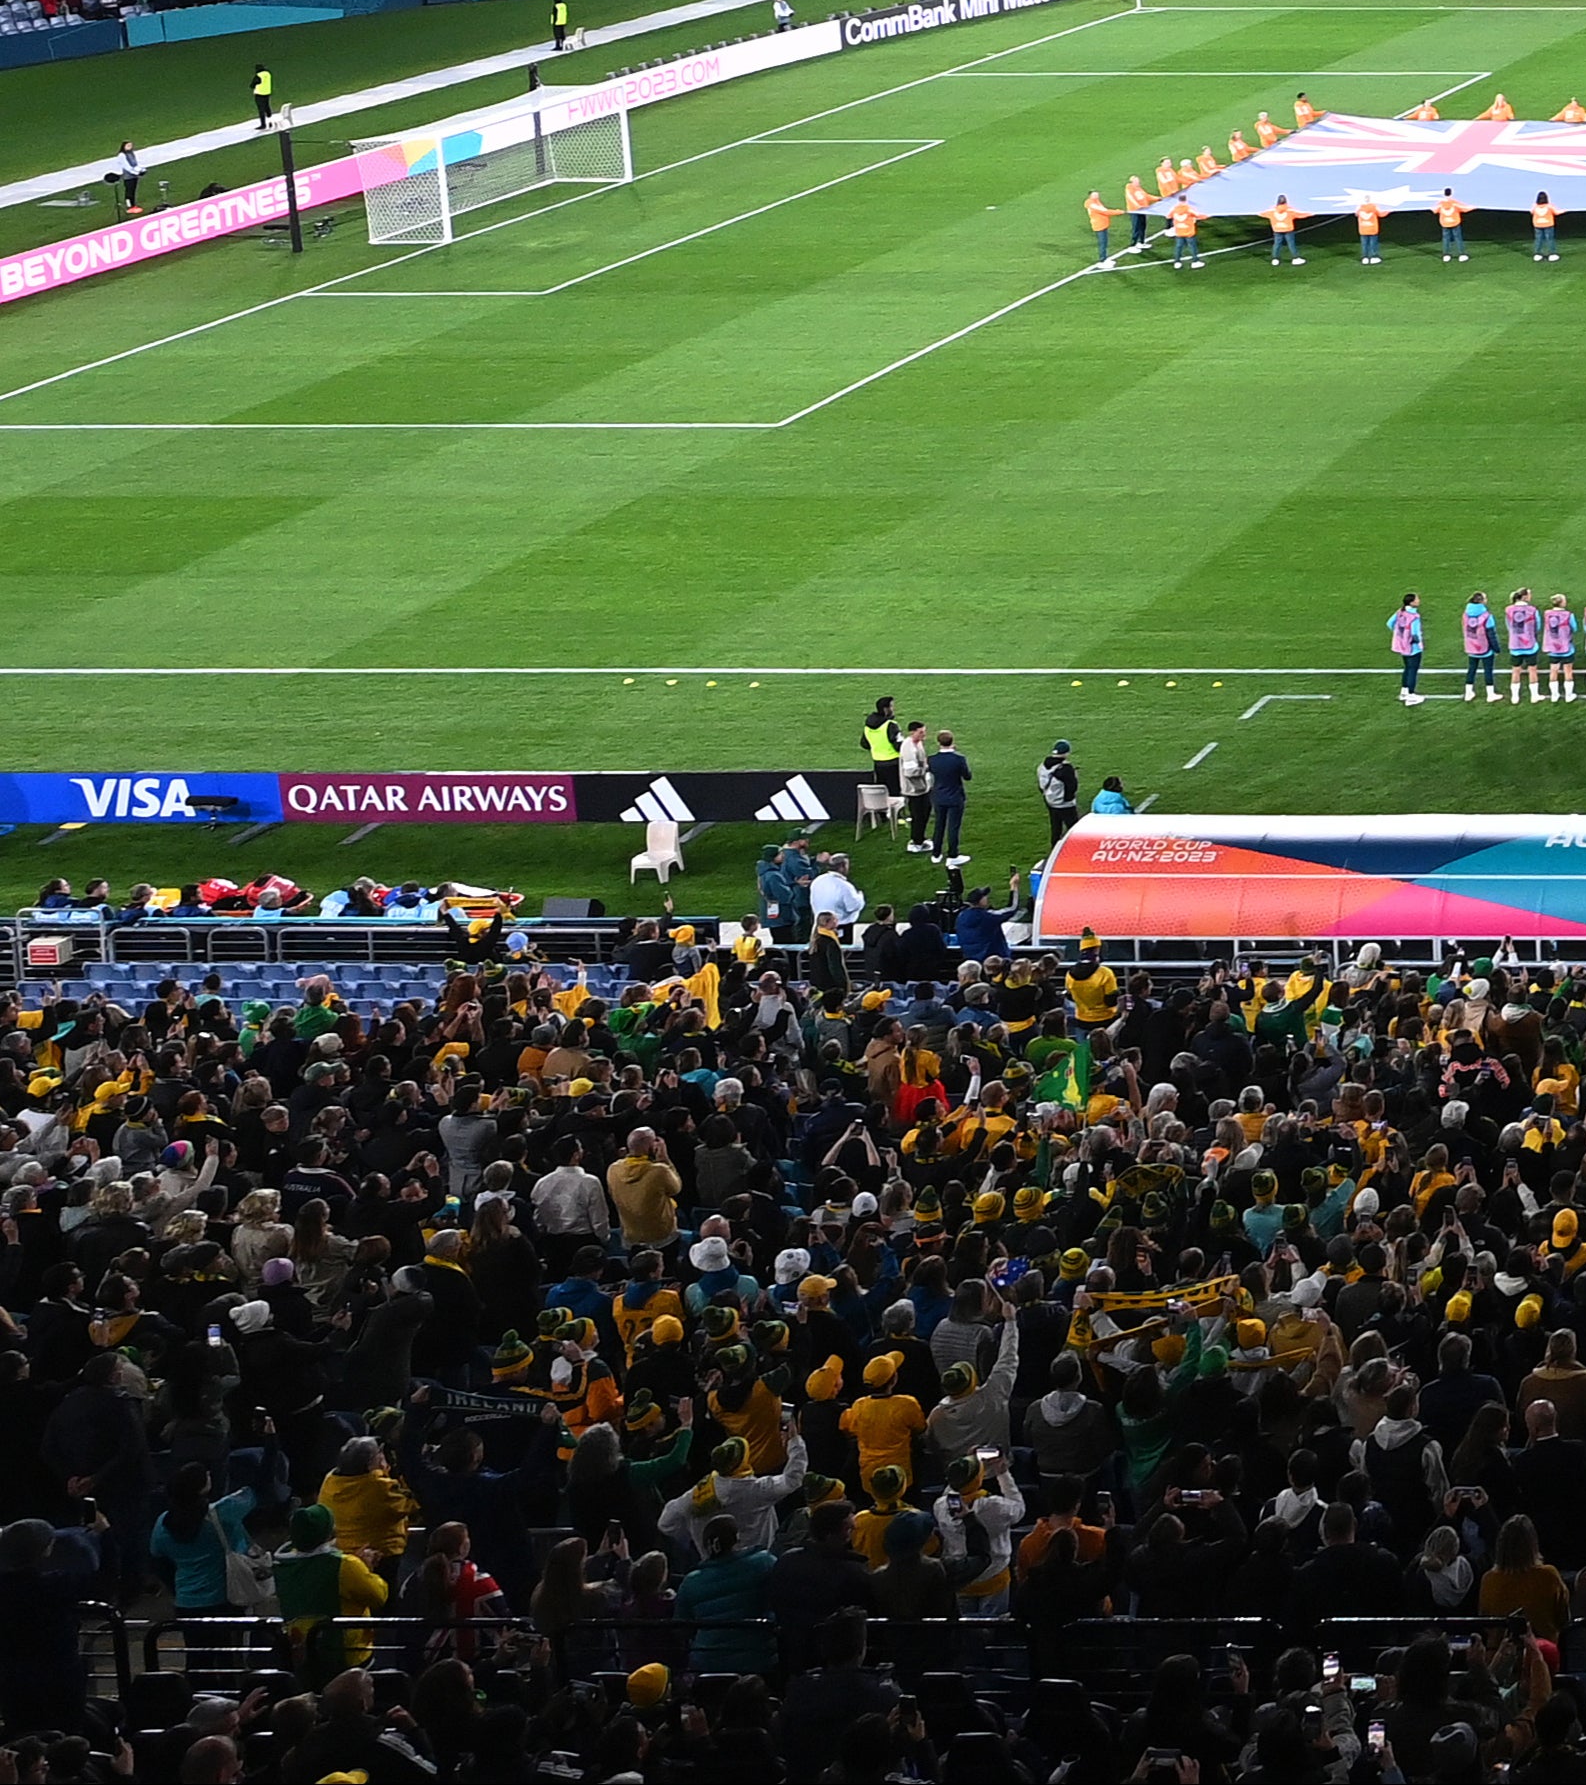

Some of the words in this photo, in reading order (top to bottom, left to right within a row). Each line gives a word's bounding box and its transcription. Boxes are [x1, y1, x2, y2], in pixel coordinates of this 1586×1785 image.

[0, 233, 134, 301] BEYOND
[69, 777, 194, 819] VISA
[287, 783, 412, 816] QATAR
[419, 782, 569, 815] AIRWAYS
[1099, 840, 1172, 851] WORLD
[1171, 840, 1213, 851] CUP
[447, 1391, 538, 1415] IRELAND
